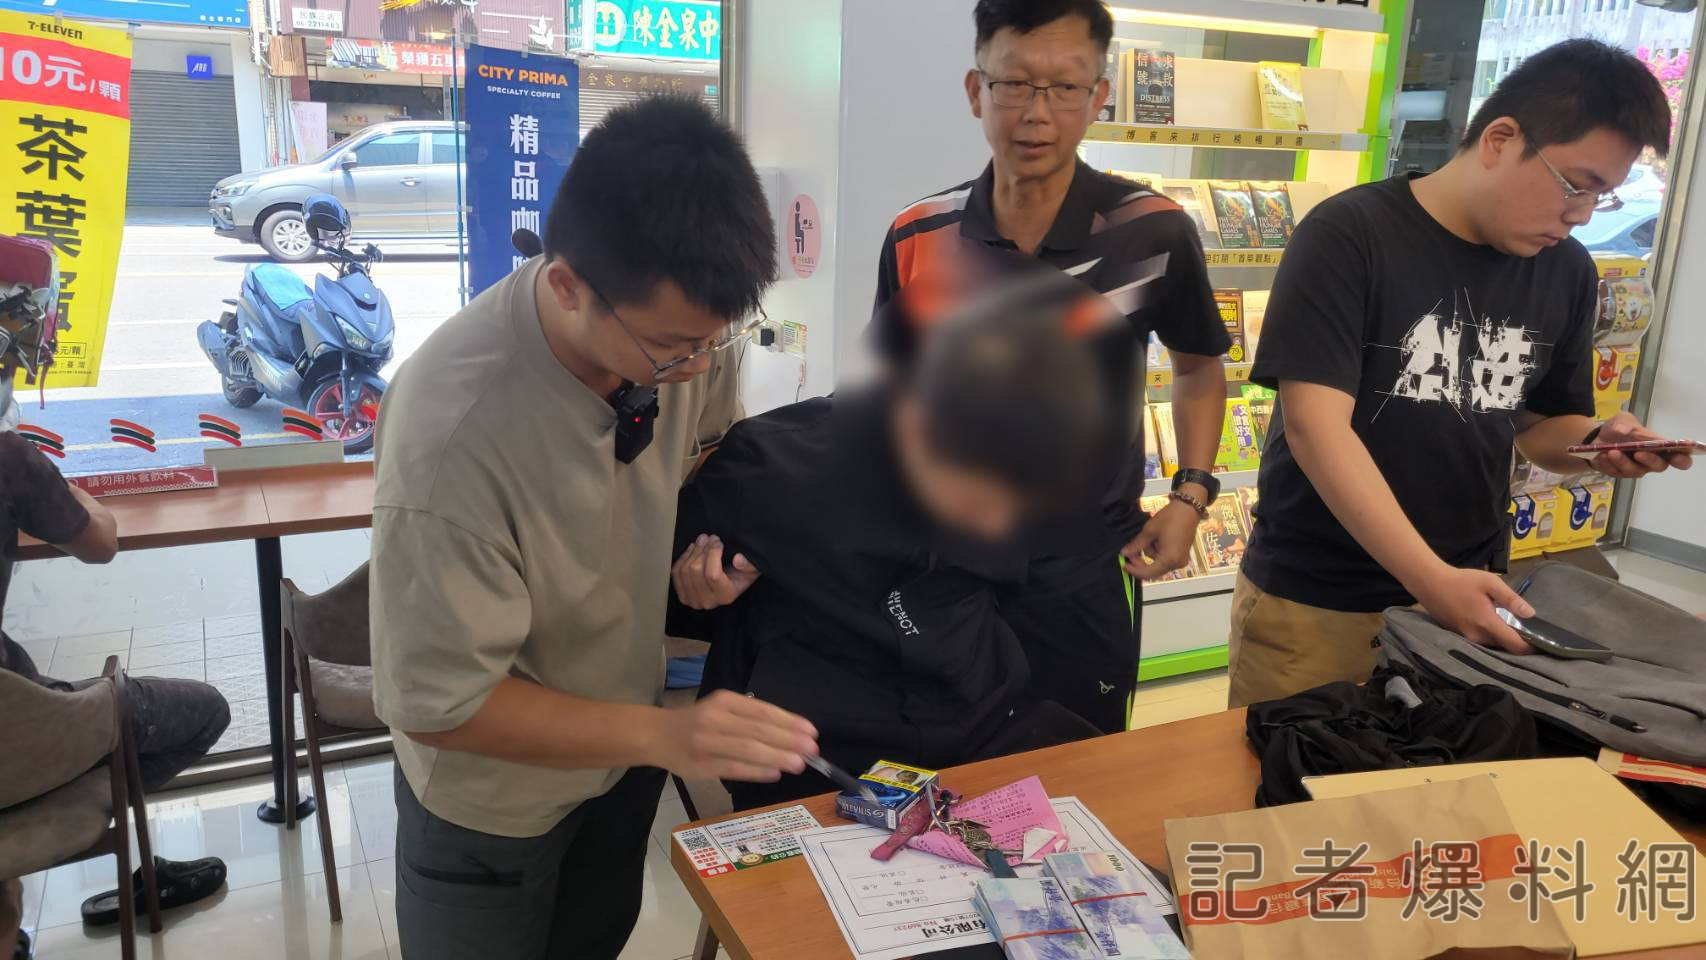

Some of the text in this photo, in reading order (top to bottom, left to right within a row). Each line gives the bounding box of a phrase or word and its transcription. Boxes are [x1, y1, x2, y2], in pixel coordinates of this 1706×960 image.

[633, 5, 719, 55] 陳金泉中
[478, 64, 568, 87] CITY PRIMA
[487, 86, 561, 99] SPECIALTY COFFEE
[510, 114, 541, 271] 精品咖
[841, 801, 872, 817] MEVIUS
[1106, 854, 1125, 872] 1000
[921, 919, 987, 939] 有限公司
